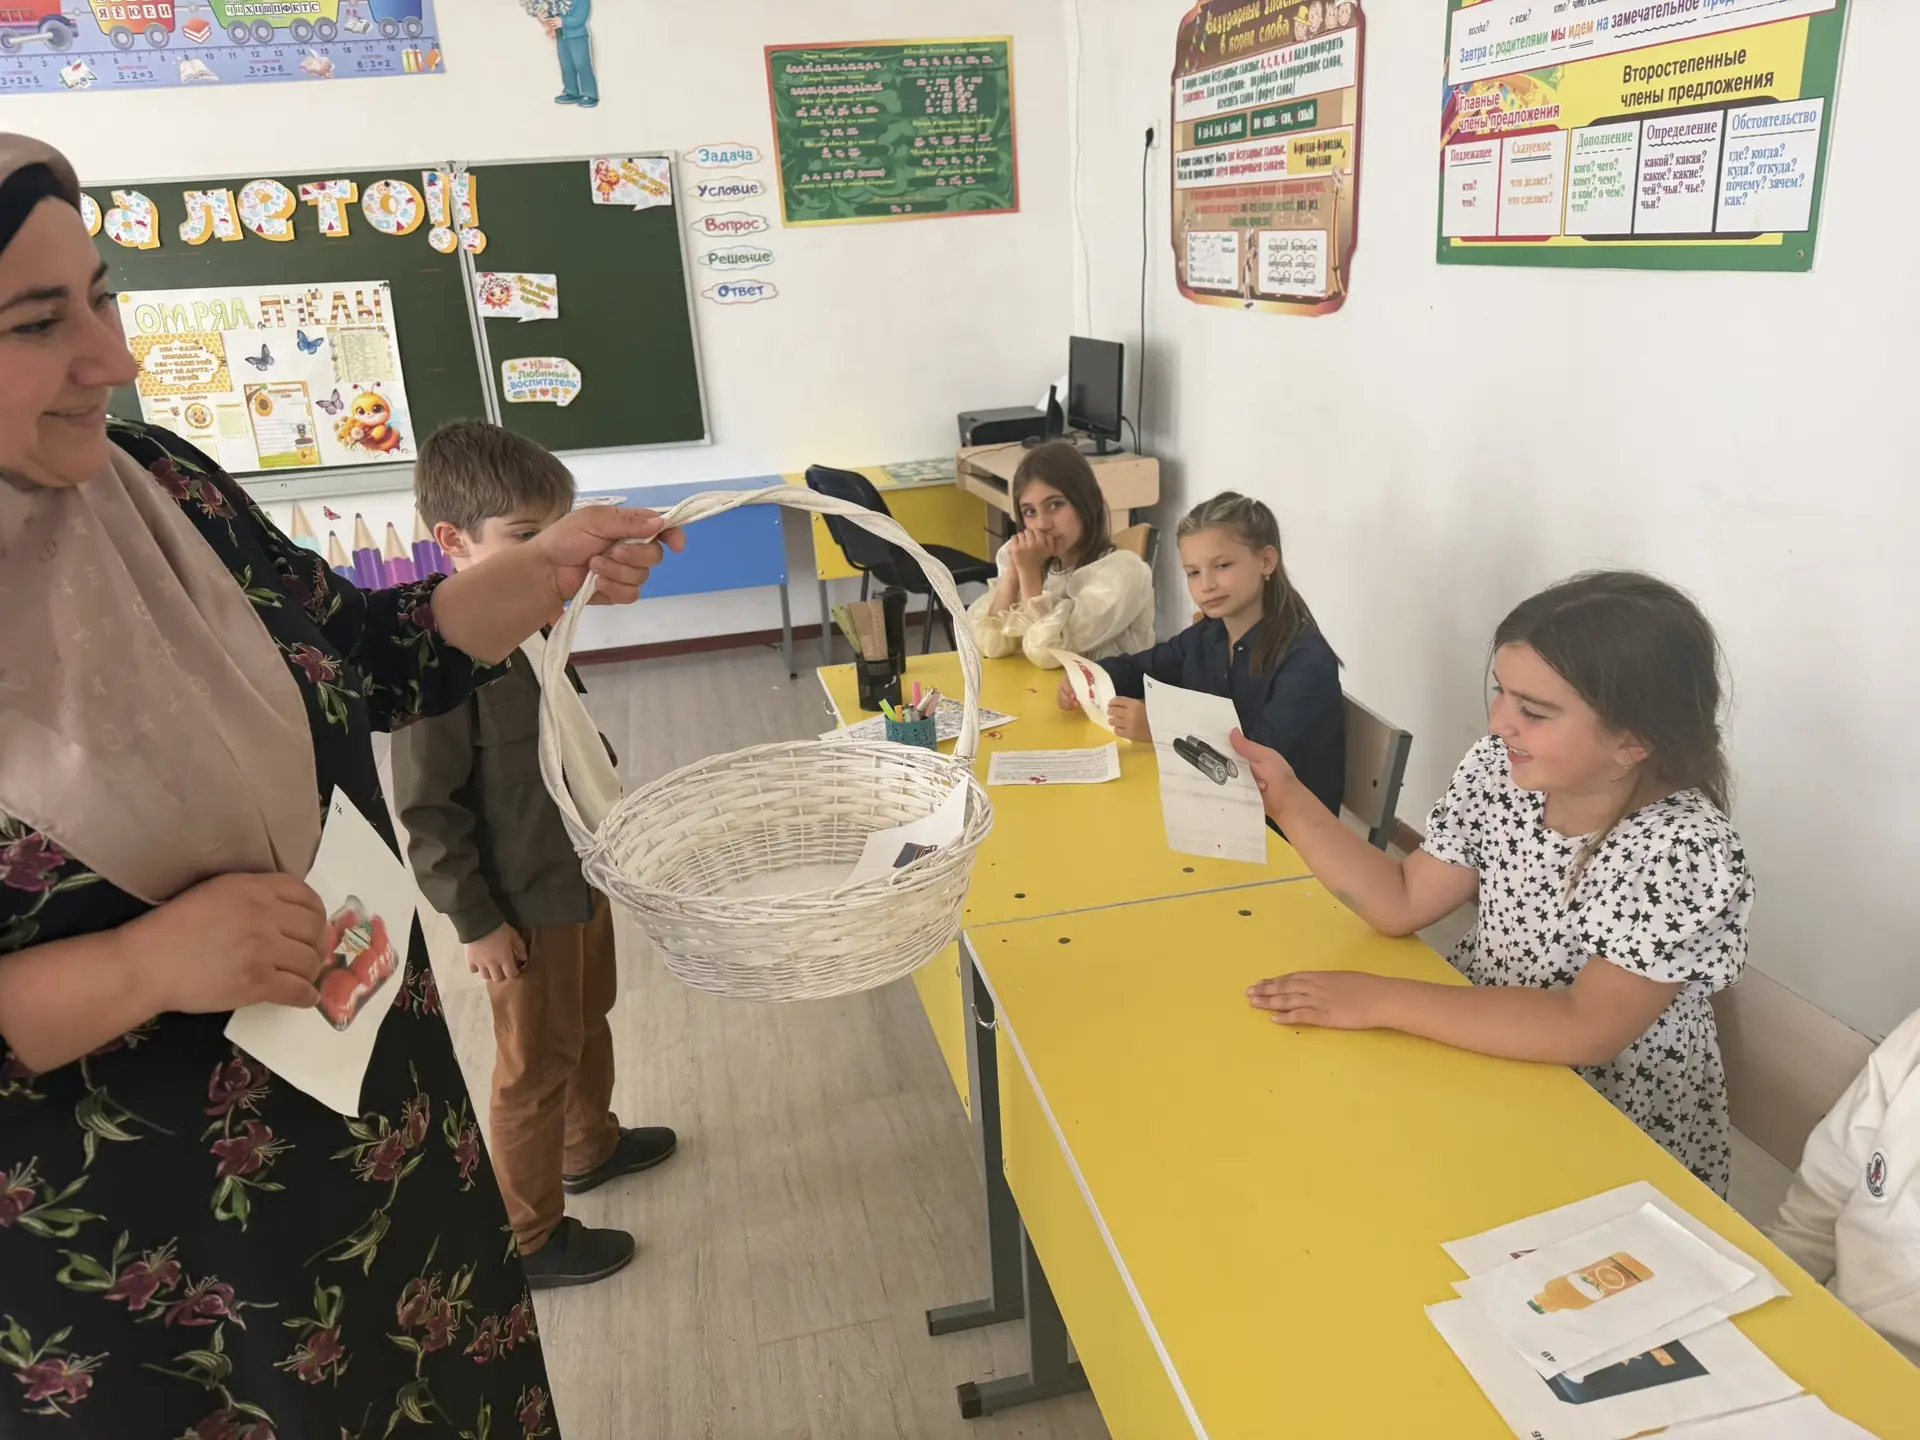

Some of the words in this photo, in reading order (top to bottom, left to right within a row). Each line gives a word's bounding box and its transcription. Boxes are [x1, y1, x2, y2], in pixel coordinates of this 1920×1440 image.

[1515, 9, 1532, 23] кем?
[1460, 45, 1487, 63] Завтра
[1495, 31, 1549, 59] родителями
[1551, 27, 1566, 42] мы
[1568, 20, 1594, 40] идем
[1596, 16, 1609, 32] на
[1611, 0, 1699, 29] замечательное
[1468, 20, 1490, 35] когда?
[1623, 49, 1747, 84] Второстепенные
[1621, 88, 1664, 108] члены
[1668, 71, 1774, 104] предложения
[1459, 93, 1500, 111] Главные
[1458, 117, 1488, 132] члены
[1491, 104, 1560, 130] предложения
[1732, 110, 1817, 131] Обстоятельство
[1577, 131, 1633, 148] Дополнение
[1647, 121, 1718, 142] Определение
[698, 148, 753, 163] Задача
[1450, 147, 1492, 161] Подлежащее
[1512, 140, 1552, 156] Сказуемое
[1729, 145, 1750, 162] где?
[1751, 142, 1786, 160] когда?
[1573, 158, 1596, 173] кого?
[1597, 157, 1618, 171] чего?
[1644, 152, 1675, 168] какой?
[1675, 149, 1707, 165] какая?
[1643, 168, 1671, 182] какое?
[1672, 165, 1704, 180] какие?
[1727, 160, 1755, 179] куда?
[1756, 157, 1798, 177] откуда?
[1573, 172, 1596, 188] кому?
[1598, 171, 1622, 187] чему?
[1641, 181, 1661, 196] чей?
[1662, 180, 1683, 194] чья?
[1685, 179, 1705, 193] чье?
[1725, 175, 1767, 194] почему?
[1768, 172, 1805, 189] зачем?
[698, 183, 759, 198] Условие
[1724, 191, 1748, 206] как?
[1571, 200, 1588, 212] что?
[1641, 195, 1660, 209] чьи?
[705, 217, 760, 234] Вопрос
[708, 251, 771, 265] Решение
[718, 284, 764, 297] Ответ
